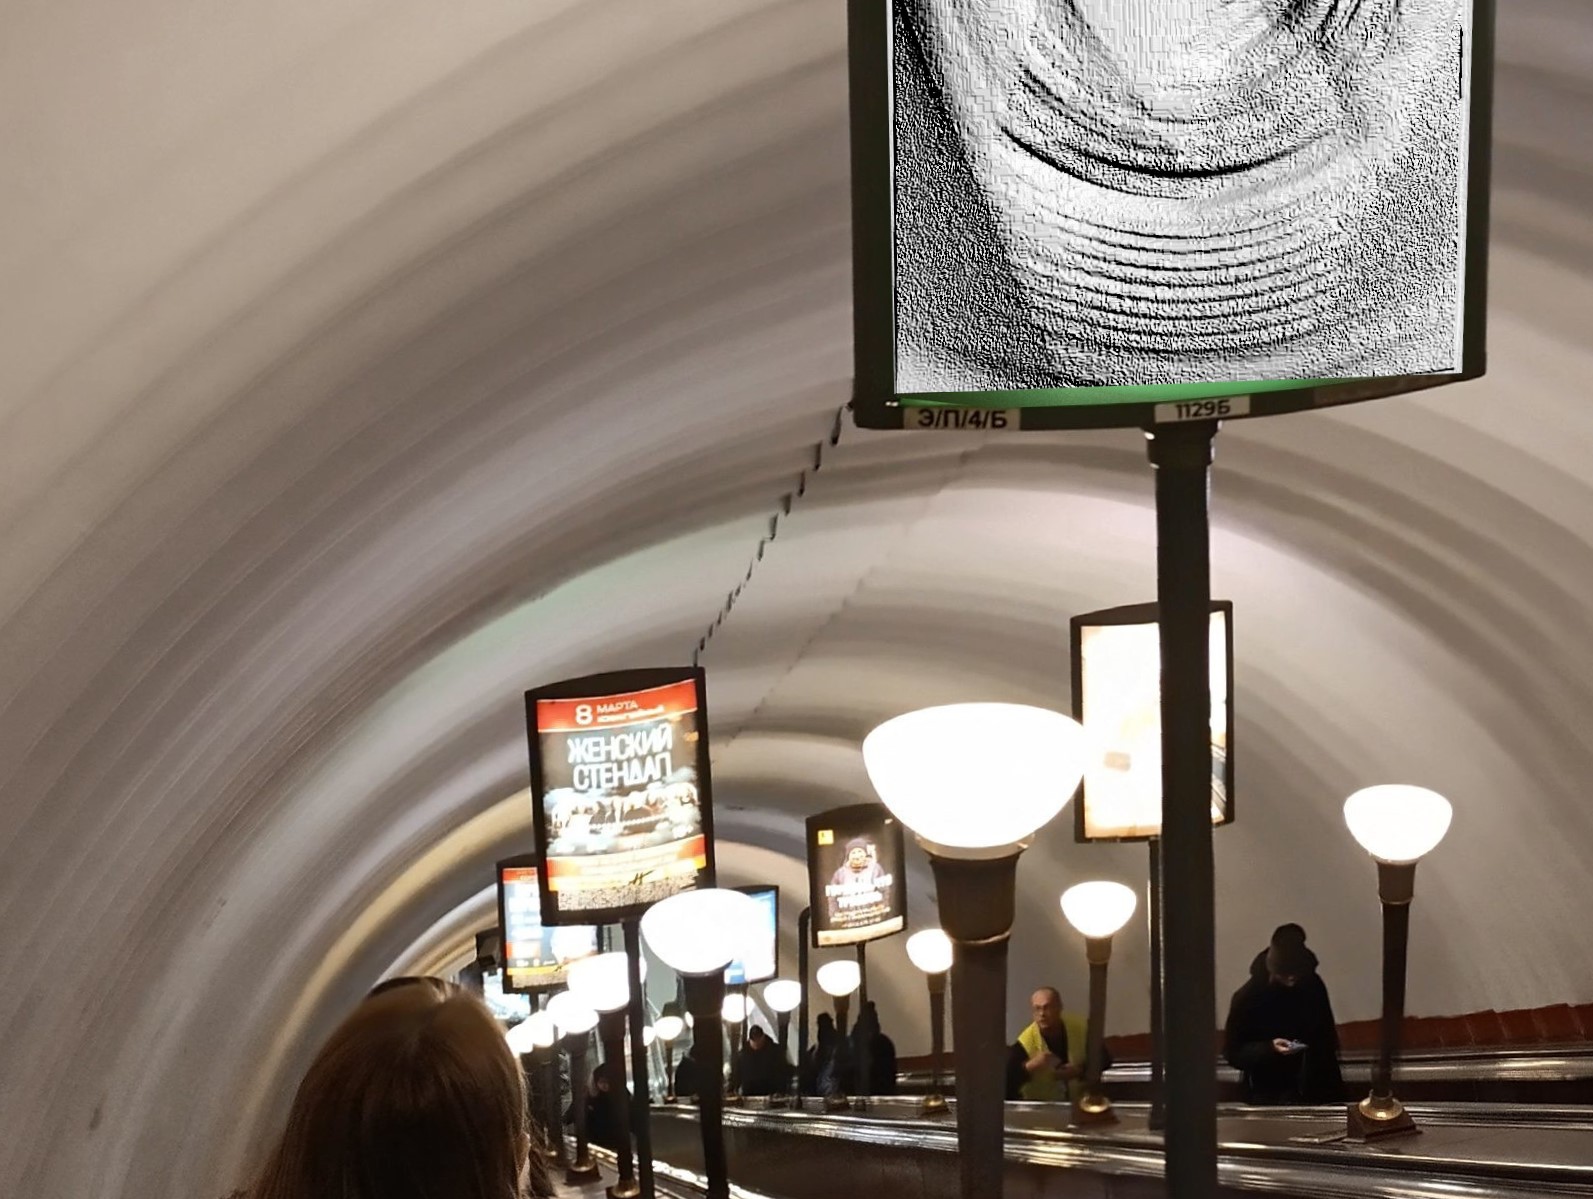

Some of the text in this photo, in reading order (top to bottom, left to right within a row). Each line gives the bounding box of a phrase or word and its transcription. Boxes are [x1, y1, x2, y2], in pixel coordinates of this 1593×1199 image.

[575, 704, 594, 726] 8
[596, 700, 639, 714] МАРТА
[566, 722, 673, 765] ЖЕНСКИЙ
[573, 751, 673, 791] СТЕНДАП
